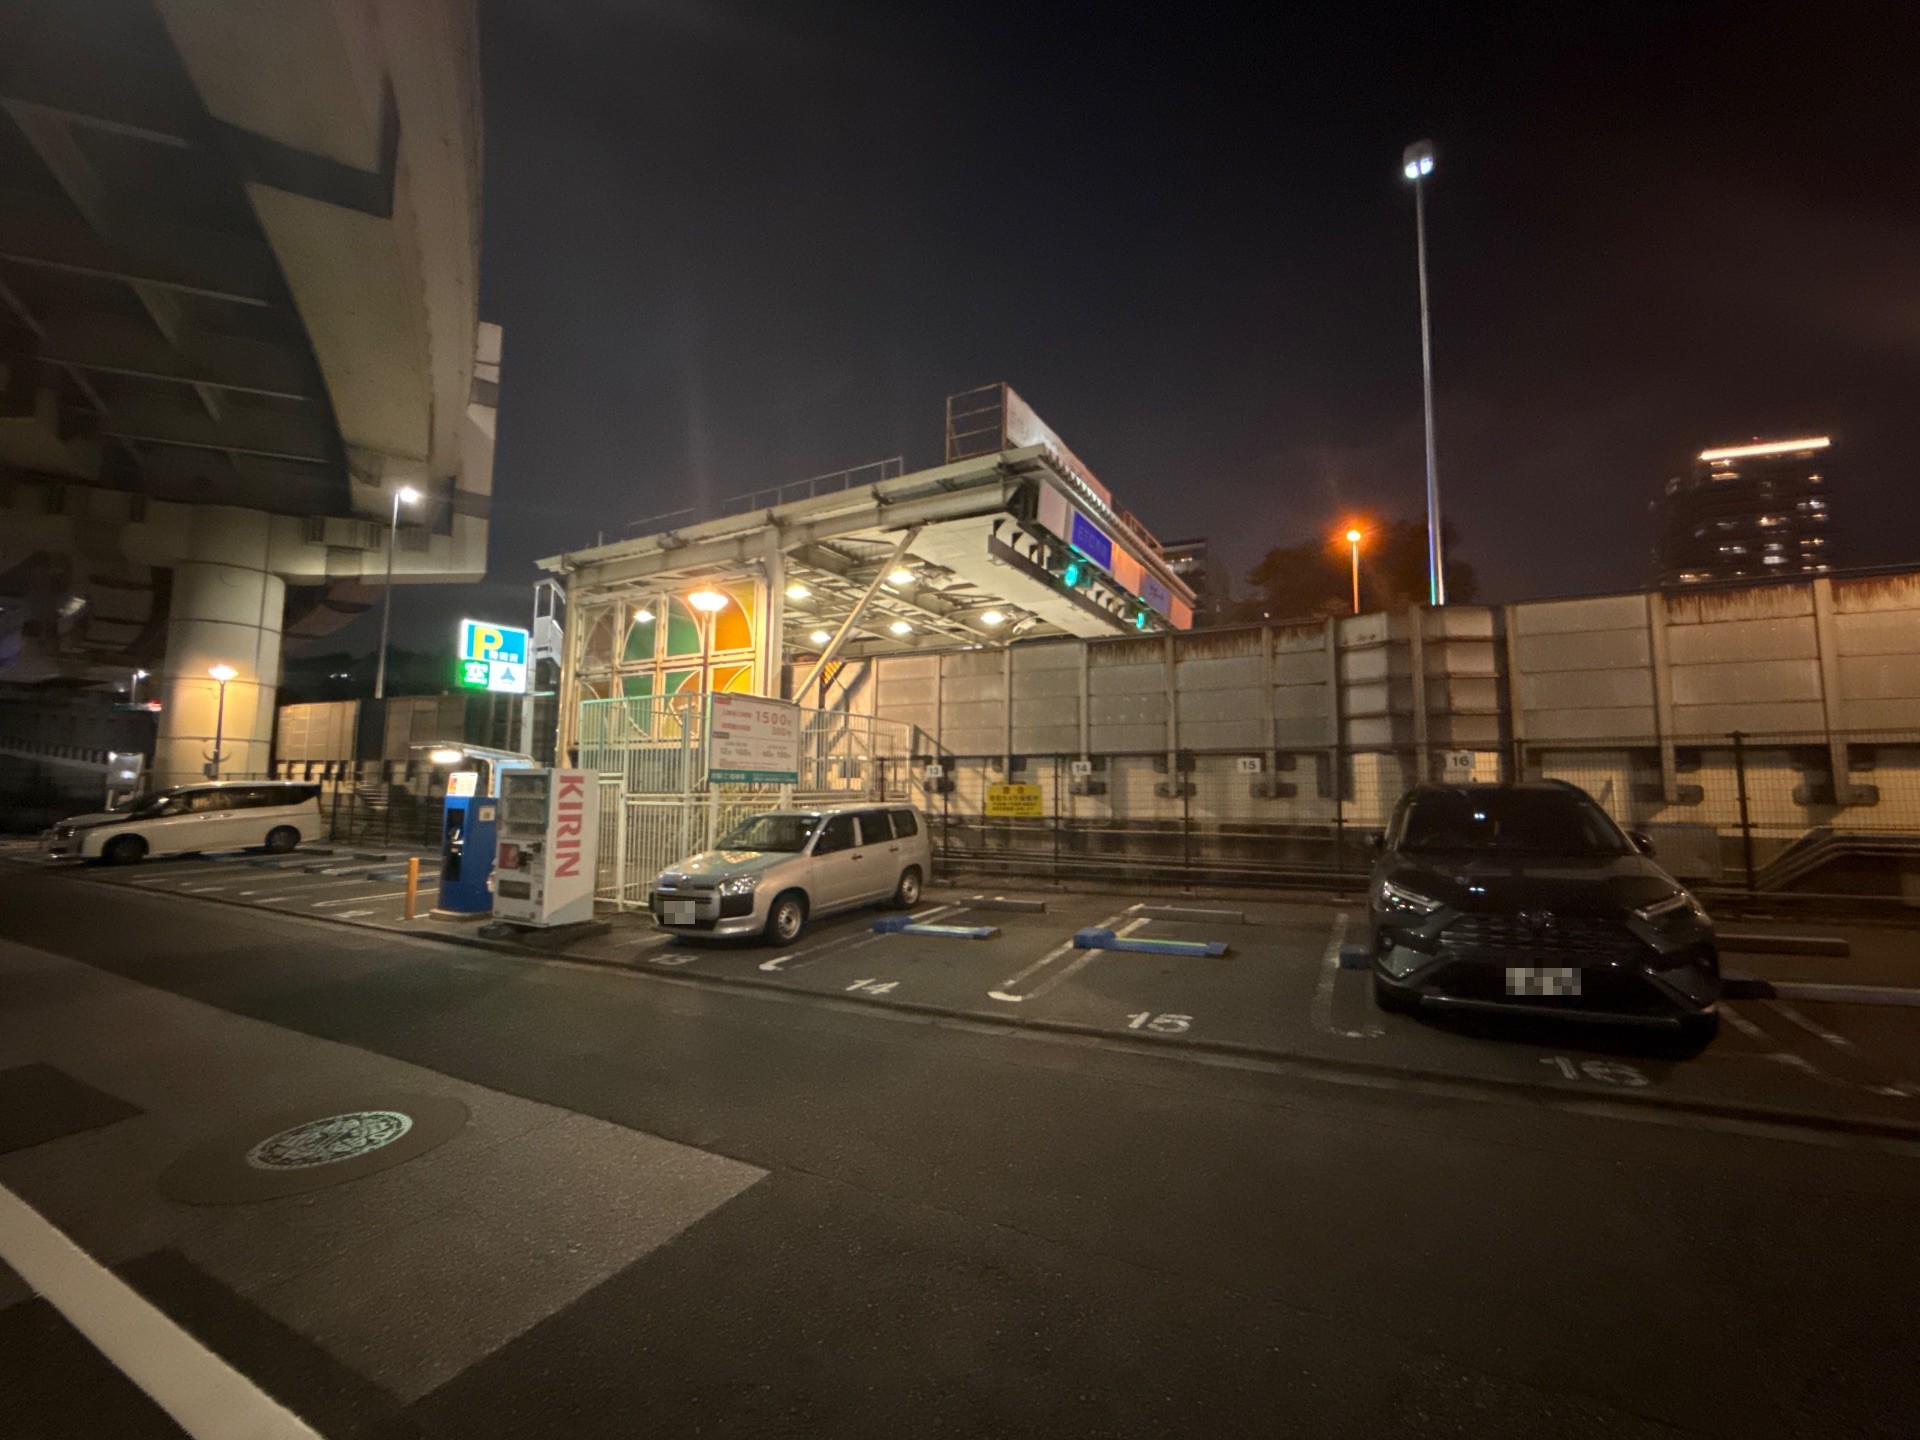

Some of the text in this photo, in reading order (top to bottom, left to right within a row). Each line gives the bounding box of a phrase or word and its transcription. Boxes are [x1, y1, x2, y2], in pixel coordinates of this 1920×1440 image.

[474, 626, 503, 660] P
[1076, 763, 1088, 773] 14
[1242, 760, 1256, 771] 15
[1451, 755, 1470, 767] 16
[929, 767, 939, 775] 13
[554, 775, 584, 878] KIRIN
[846, 978, 900, 994] 14
[1127, 1011, 1194, 1033] 15
[1537, 1056, 1650, 1086] 16
